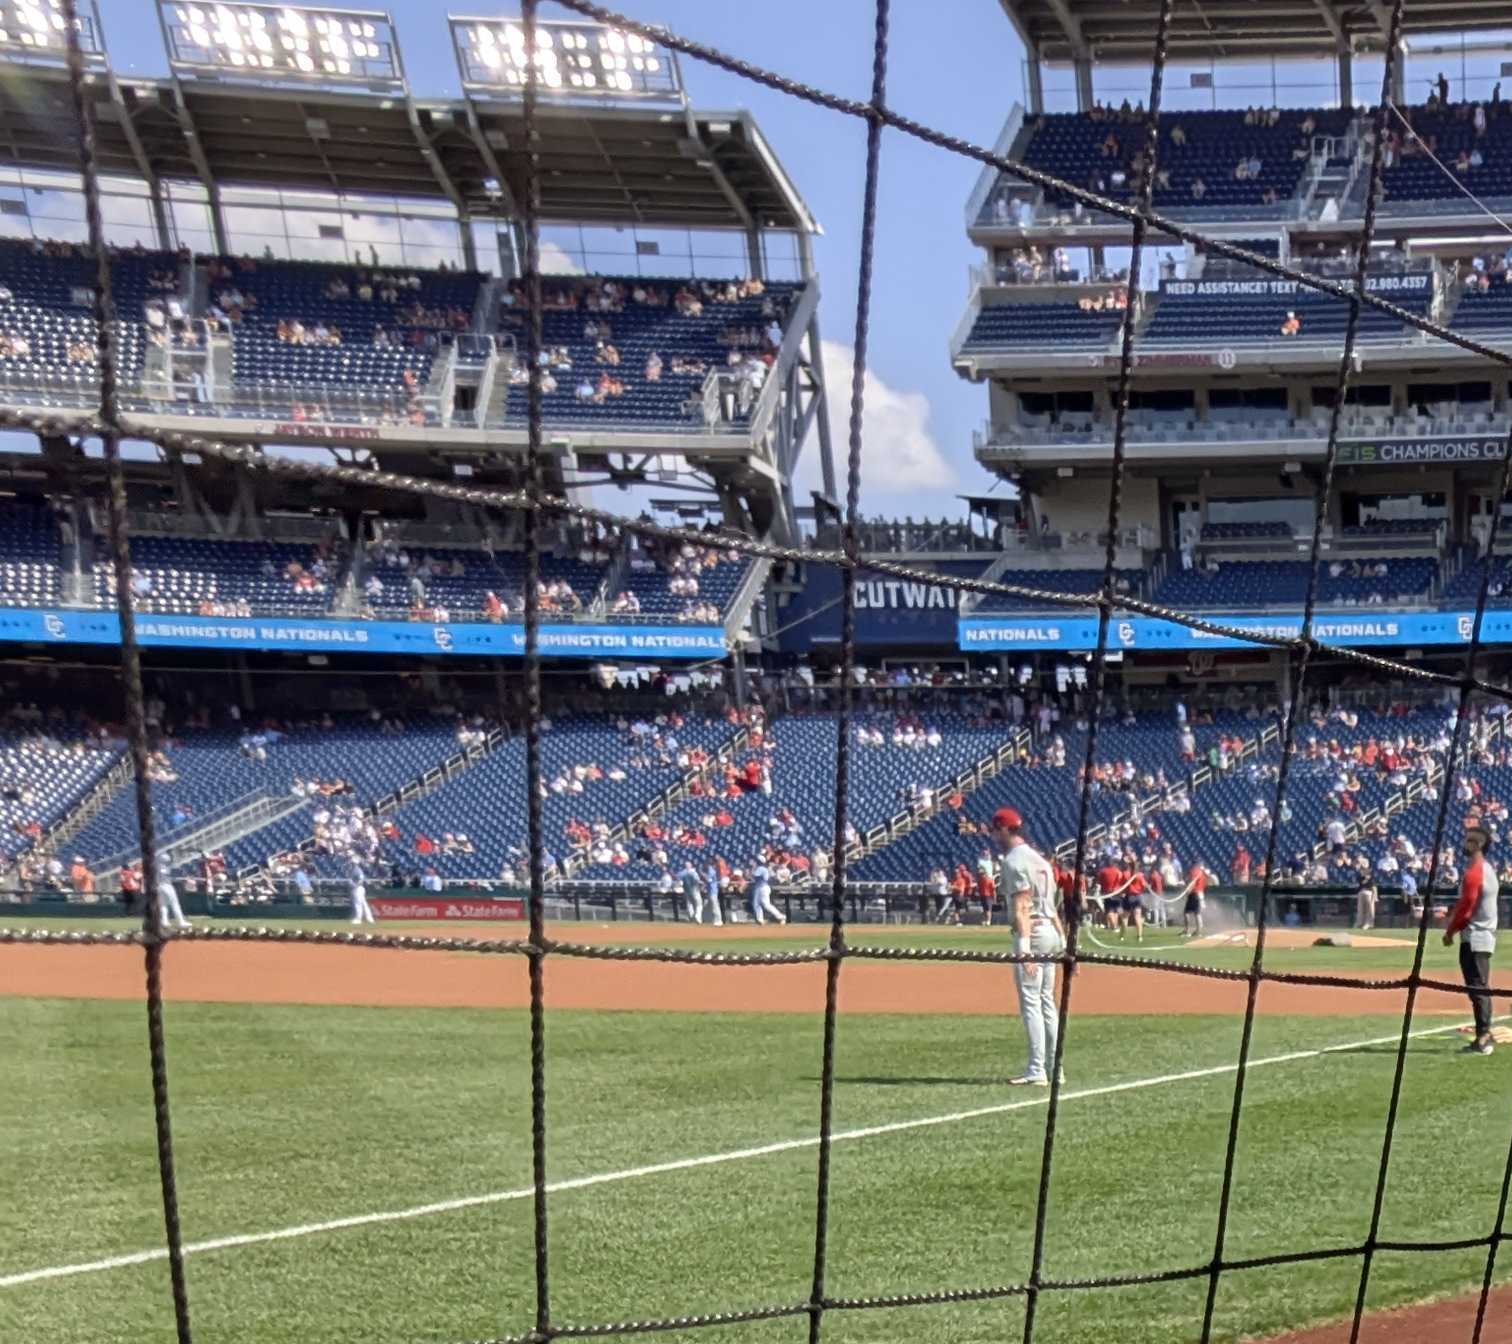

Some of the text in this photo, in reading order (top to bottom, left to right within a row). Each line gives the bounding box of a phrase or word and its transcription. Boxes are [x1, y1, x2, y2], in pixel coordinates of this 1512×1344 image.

[1166, 280, 1195, 294] NEED
[1270, 280, 1299, 294] TEXT
[1380, 442, 1480, 461] CHAMPIONS
[261, 626, 369, 643] NATIONALS
[965, 628, 1061, 641] NATIONALS
[1311, 623, 1399, 637] ATIONALS
[512, 632, 627, 647] WSHINGTON
